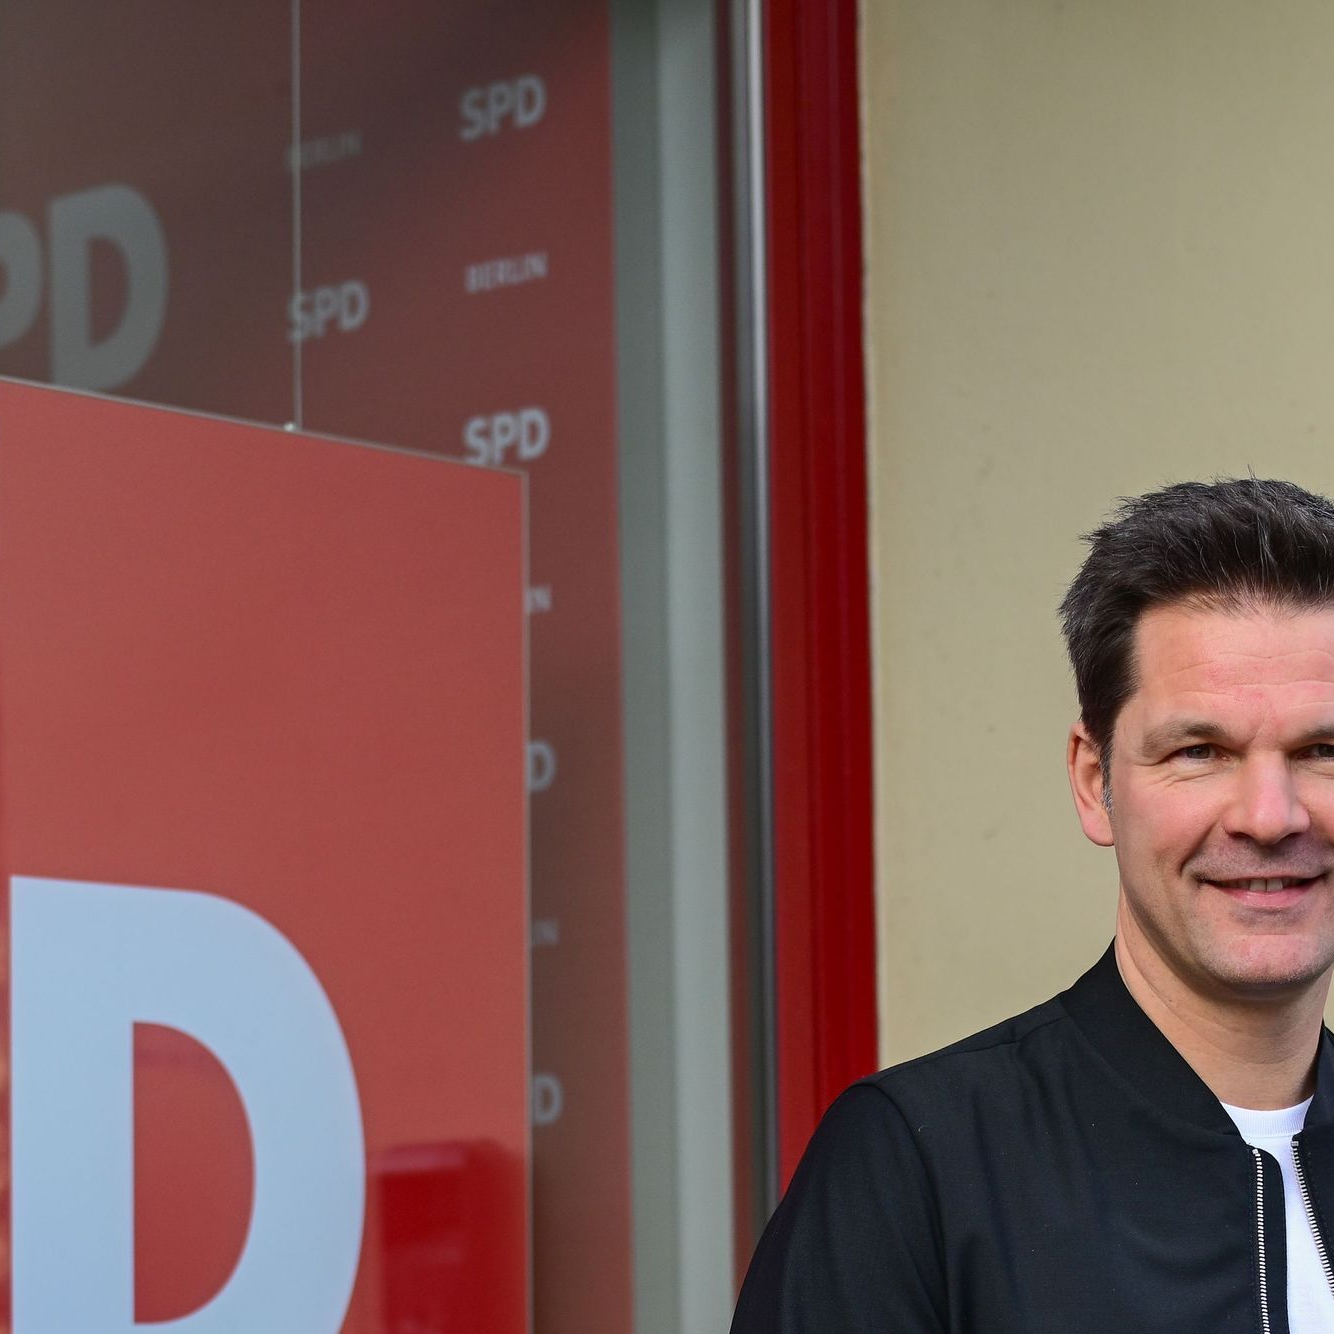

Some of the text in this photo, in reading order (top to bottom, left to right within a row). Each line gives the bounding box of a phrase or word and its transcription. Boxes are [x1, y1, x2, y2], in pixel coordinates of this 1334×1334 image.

[460, 75, 546, 141] SPD
[465, 251, 547, 294] BERLIN
[288, 280, 369, 341] SPD
[464, 406, 550, 465] SPD
